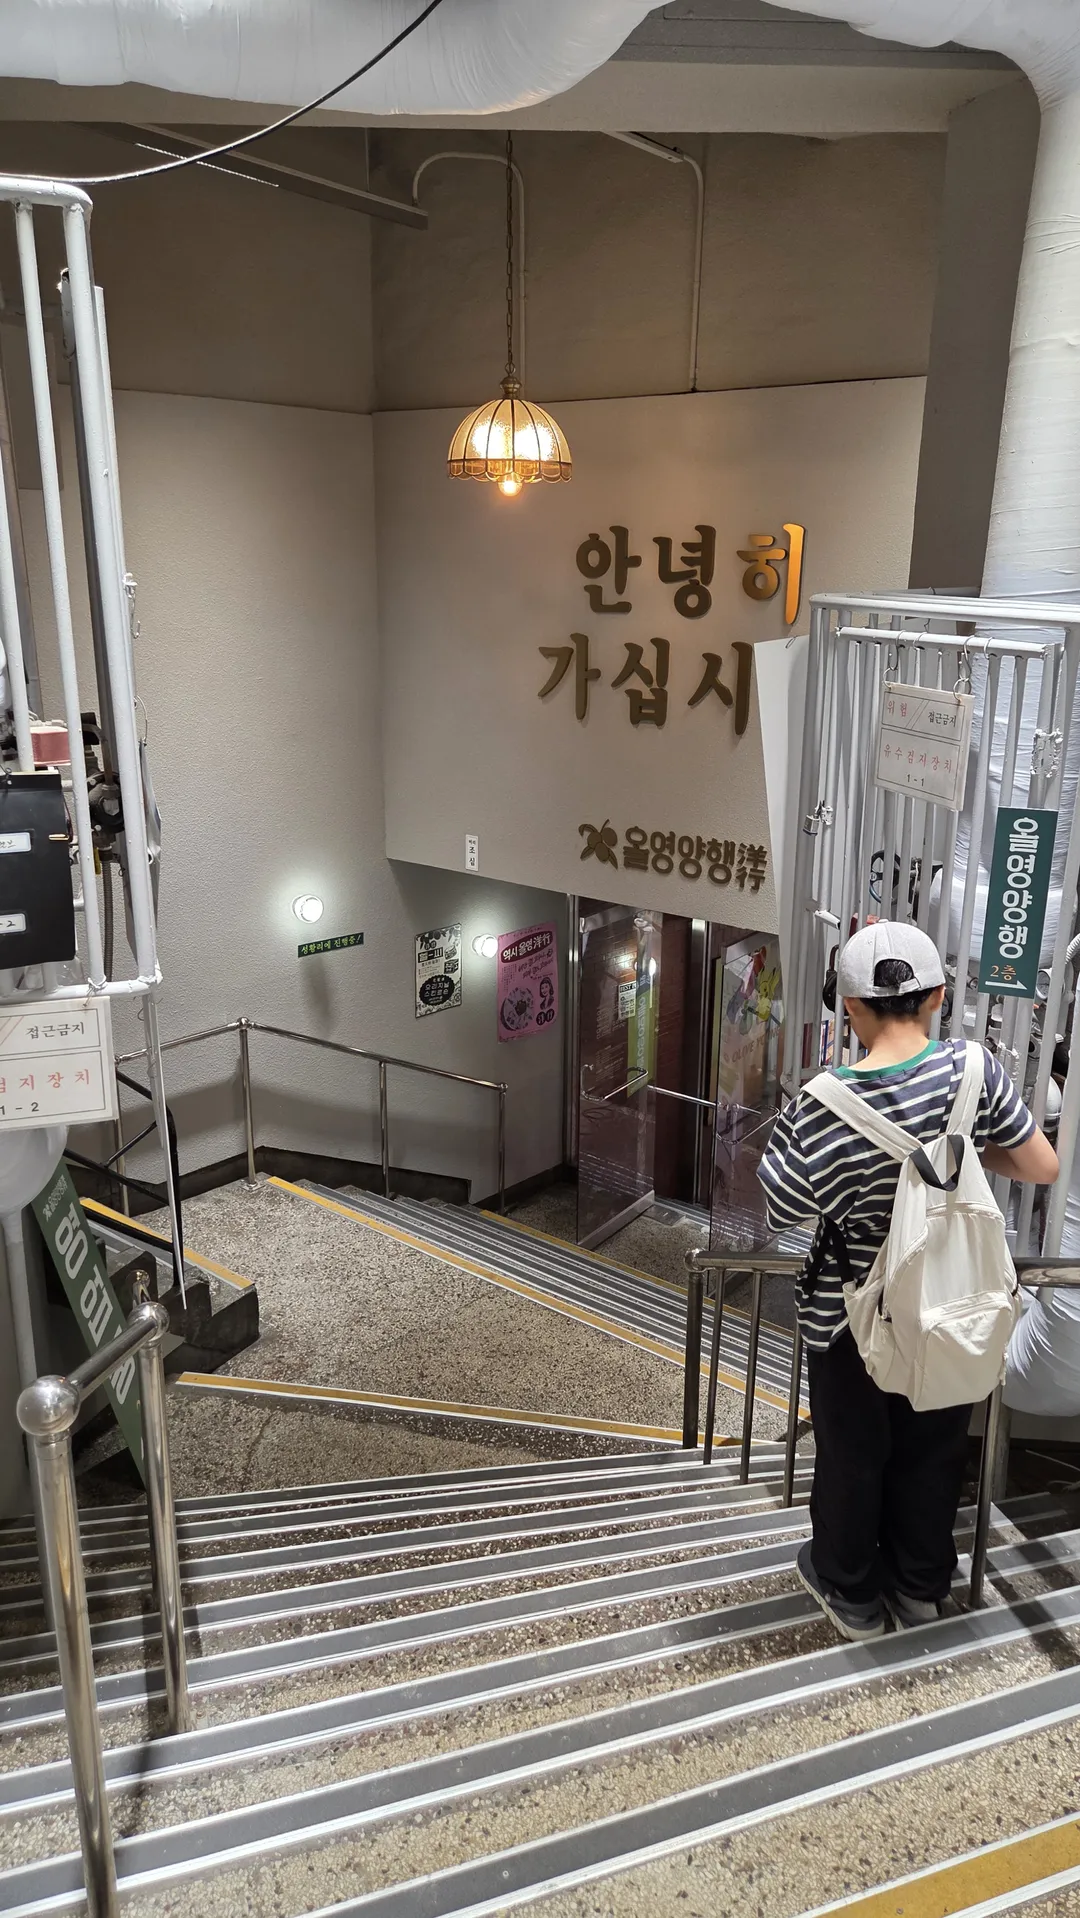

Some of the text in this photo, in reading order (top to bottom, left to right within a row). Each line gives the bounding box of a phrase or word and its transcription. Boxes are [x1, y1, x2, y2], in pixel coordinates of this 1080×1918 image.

[576, 523, 805, 625] 안녕히
[887, 701, 957, 727] 위험 접근금지
[623, 826, 736, 884] 올영양행
[998, 817, 1040, 959] 올영양행
[503, 946, 517, 960] 역시
[990, 965, 1017, 981] 2층
[25, 1022, 85, 1039] 접근금지
